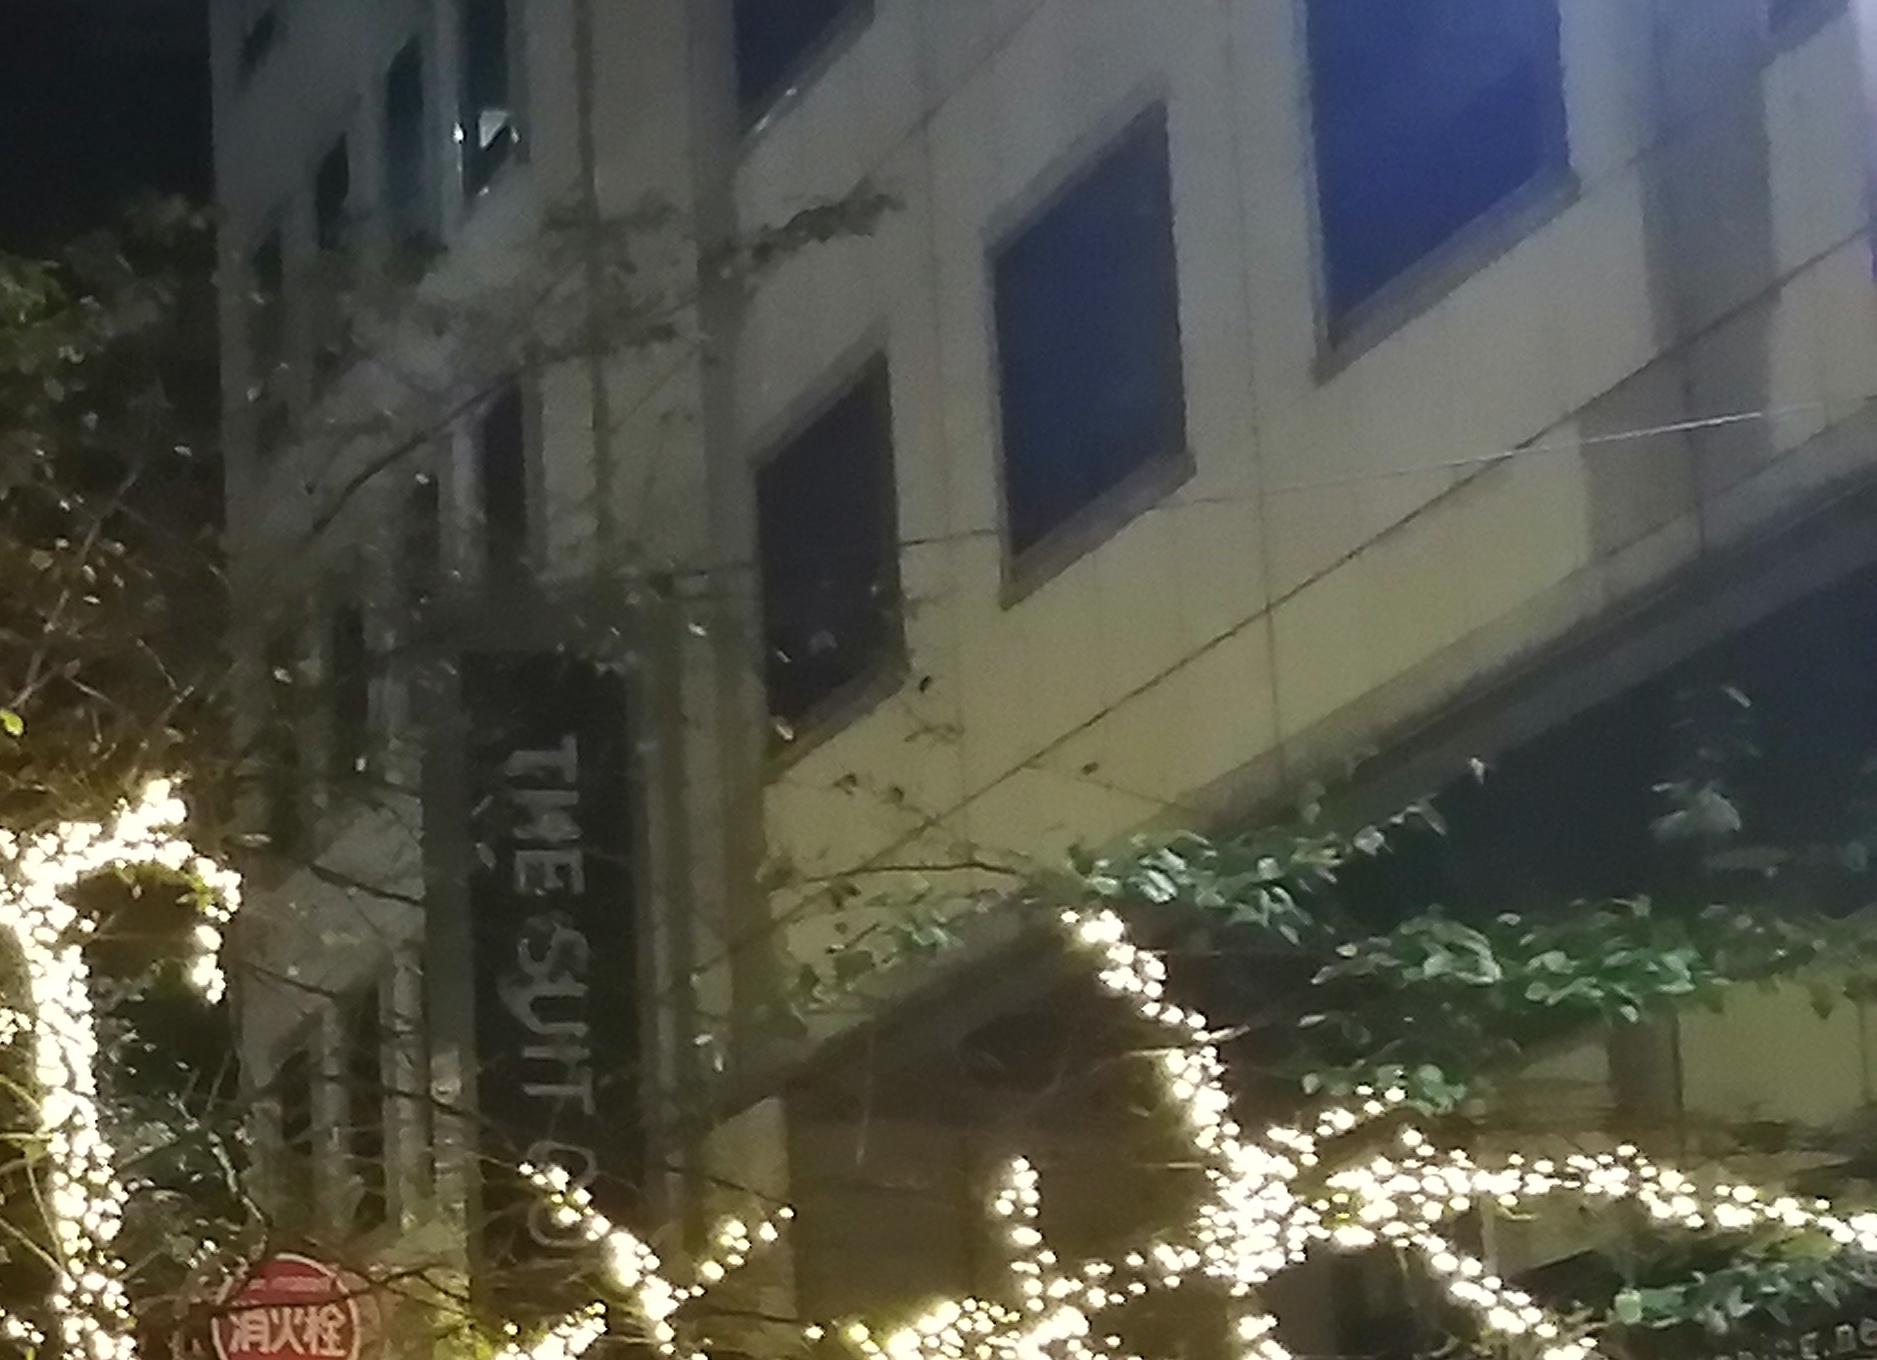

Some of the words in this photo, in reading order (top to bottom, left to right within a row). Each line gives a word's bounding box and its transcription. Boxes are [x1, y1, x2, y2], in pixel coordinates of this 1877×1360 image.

[503, 734, 586, 895] THE
[513, 918, 595, 1115] SUIT
[229, 1301, 346, 1357] 消火栓
